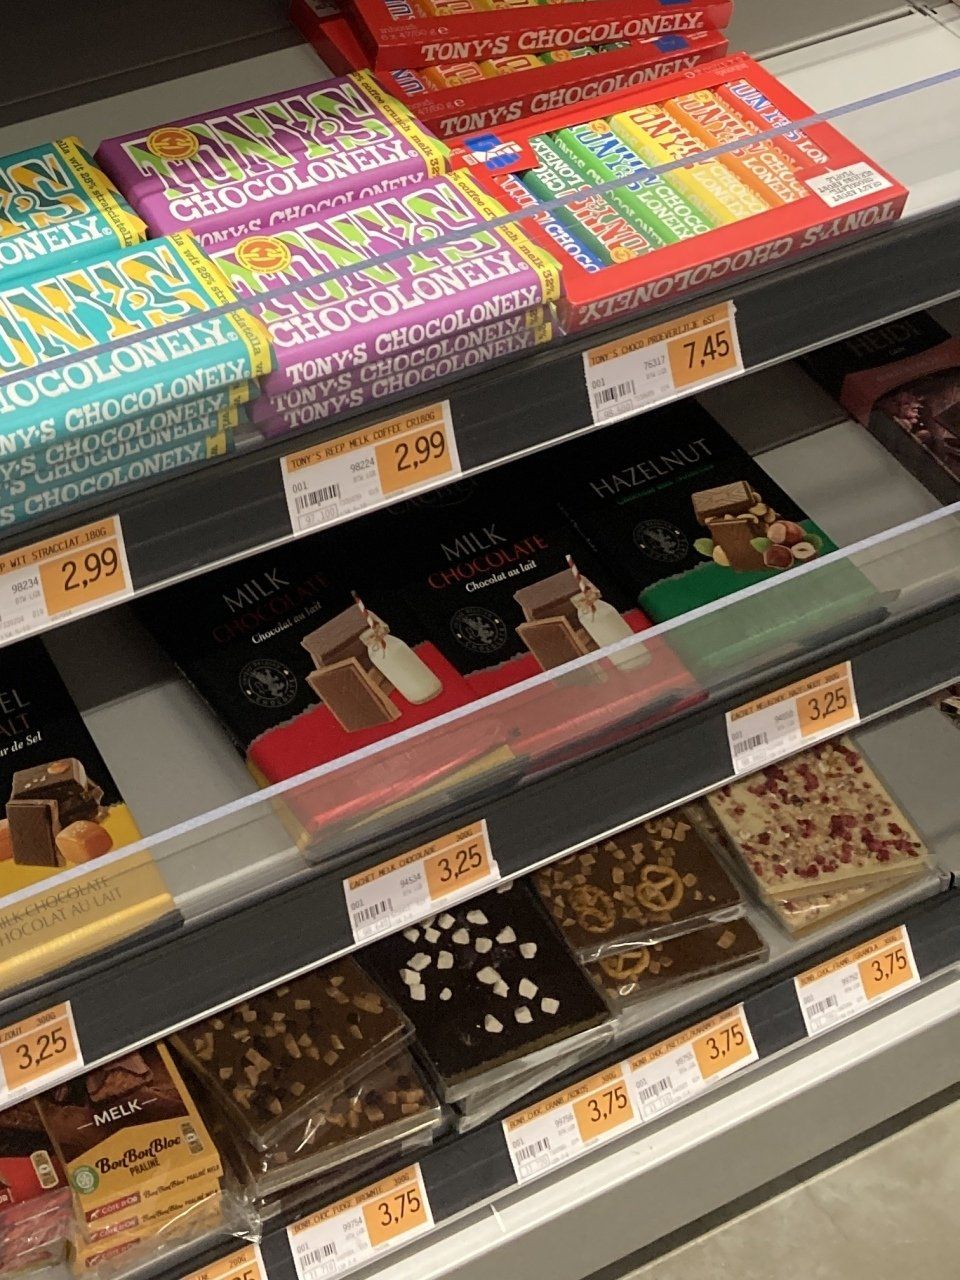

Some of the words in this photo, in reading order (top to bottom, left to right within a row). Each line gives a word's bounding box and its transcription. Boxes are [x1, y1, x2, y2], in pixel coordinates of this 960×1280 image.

[421, 37, 509, 66] TONY'S
[517, 11, 702, 54] CHOCOLONELY
[360, 85, 385, 113] coffee
[384, 112, 413, 139] crunch
[122, 84, 393, 199] TONY'S
[167, 140, 409, 222] CHOCOLONELY
[92, 186, 134, 248] stracciatella
[803, 202, 894, 248] TONY'S
[269, 251, 521, 347] CHOCOLONELY
[578, 241, 792, 327] CHOCOLONELY
[286, 342, 367, 383] TONY'S
[375, 285, 539, 357] CHOCOLONELY
[684, 331, 730, 369] 7,45
[64, 359, 250, 439] CHOCOLONELY
[349, 434, 369, 449] MELK
[373, 423, 402, 441] COFFEE
[395, 431, 445, 471] 2,99
[350, 457, 375, 472] 98224
[588, 438, 714, 498] HAZELNUT
[440, 524, 506, 561] MILK
[10, 556, 28, 568] WIT
[61, 546, 119, 592] 2,99
[427, 536, 548, 591] CHOCOLATE
[465, 570, 506, 593] Chocolat
[508, 569, 519, 581] au
[519, 560, 536, 578] lait
[11, 577, 39, 593] 98234
[222, 569, 289, 612] MILK
[808, 687, 847, 721] 3,25
[11, 740, 23, 753] de
[25, 731, 42, 746] Sel
[438, 844, 482, 882] 3,25
[94, 886, 123, 906] LAIT
[871, 948, 907, 982] 3,75
[16, 1027, 67, 1070] 3,25
[706, 1023, 744, 1060] 3,75
[93, 1099, 142, 1126] MELK
[587, 1086, 628, 1122] 3,75
[95, 1136, 181, 1174] BonBonBloc
[378, 1189, 420, 1226] 3,75
